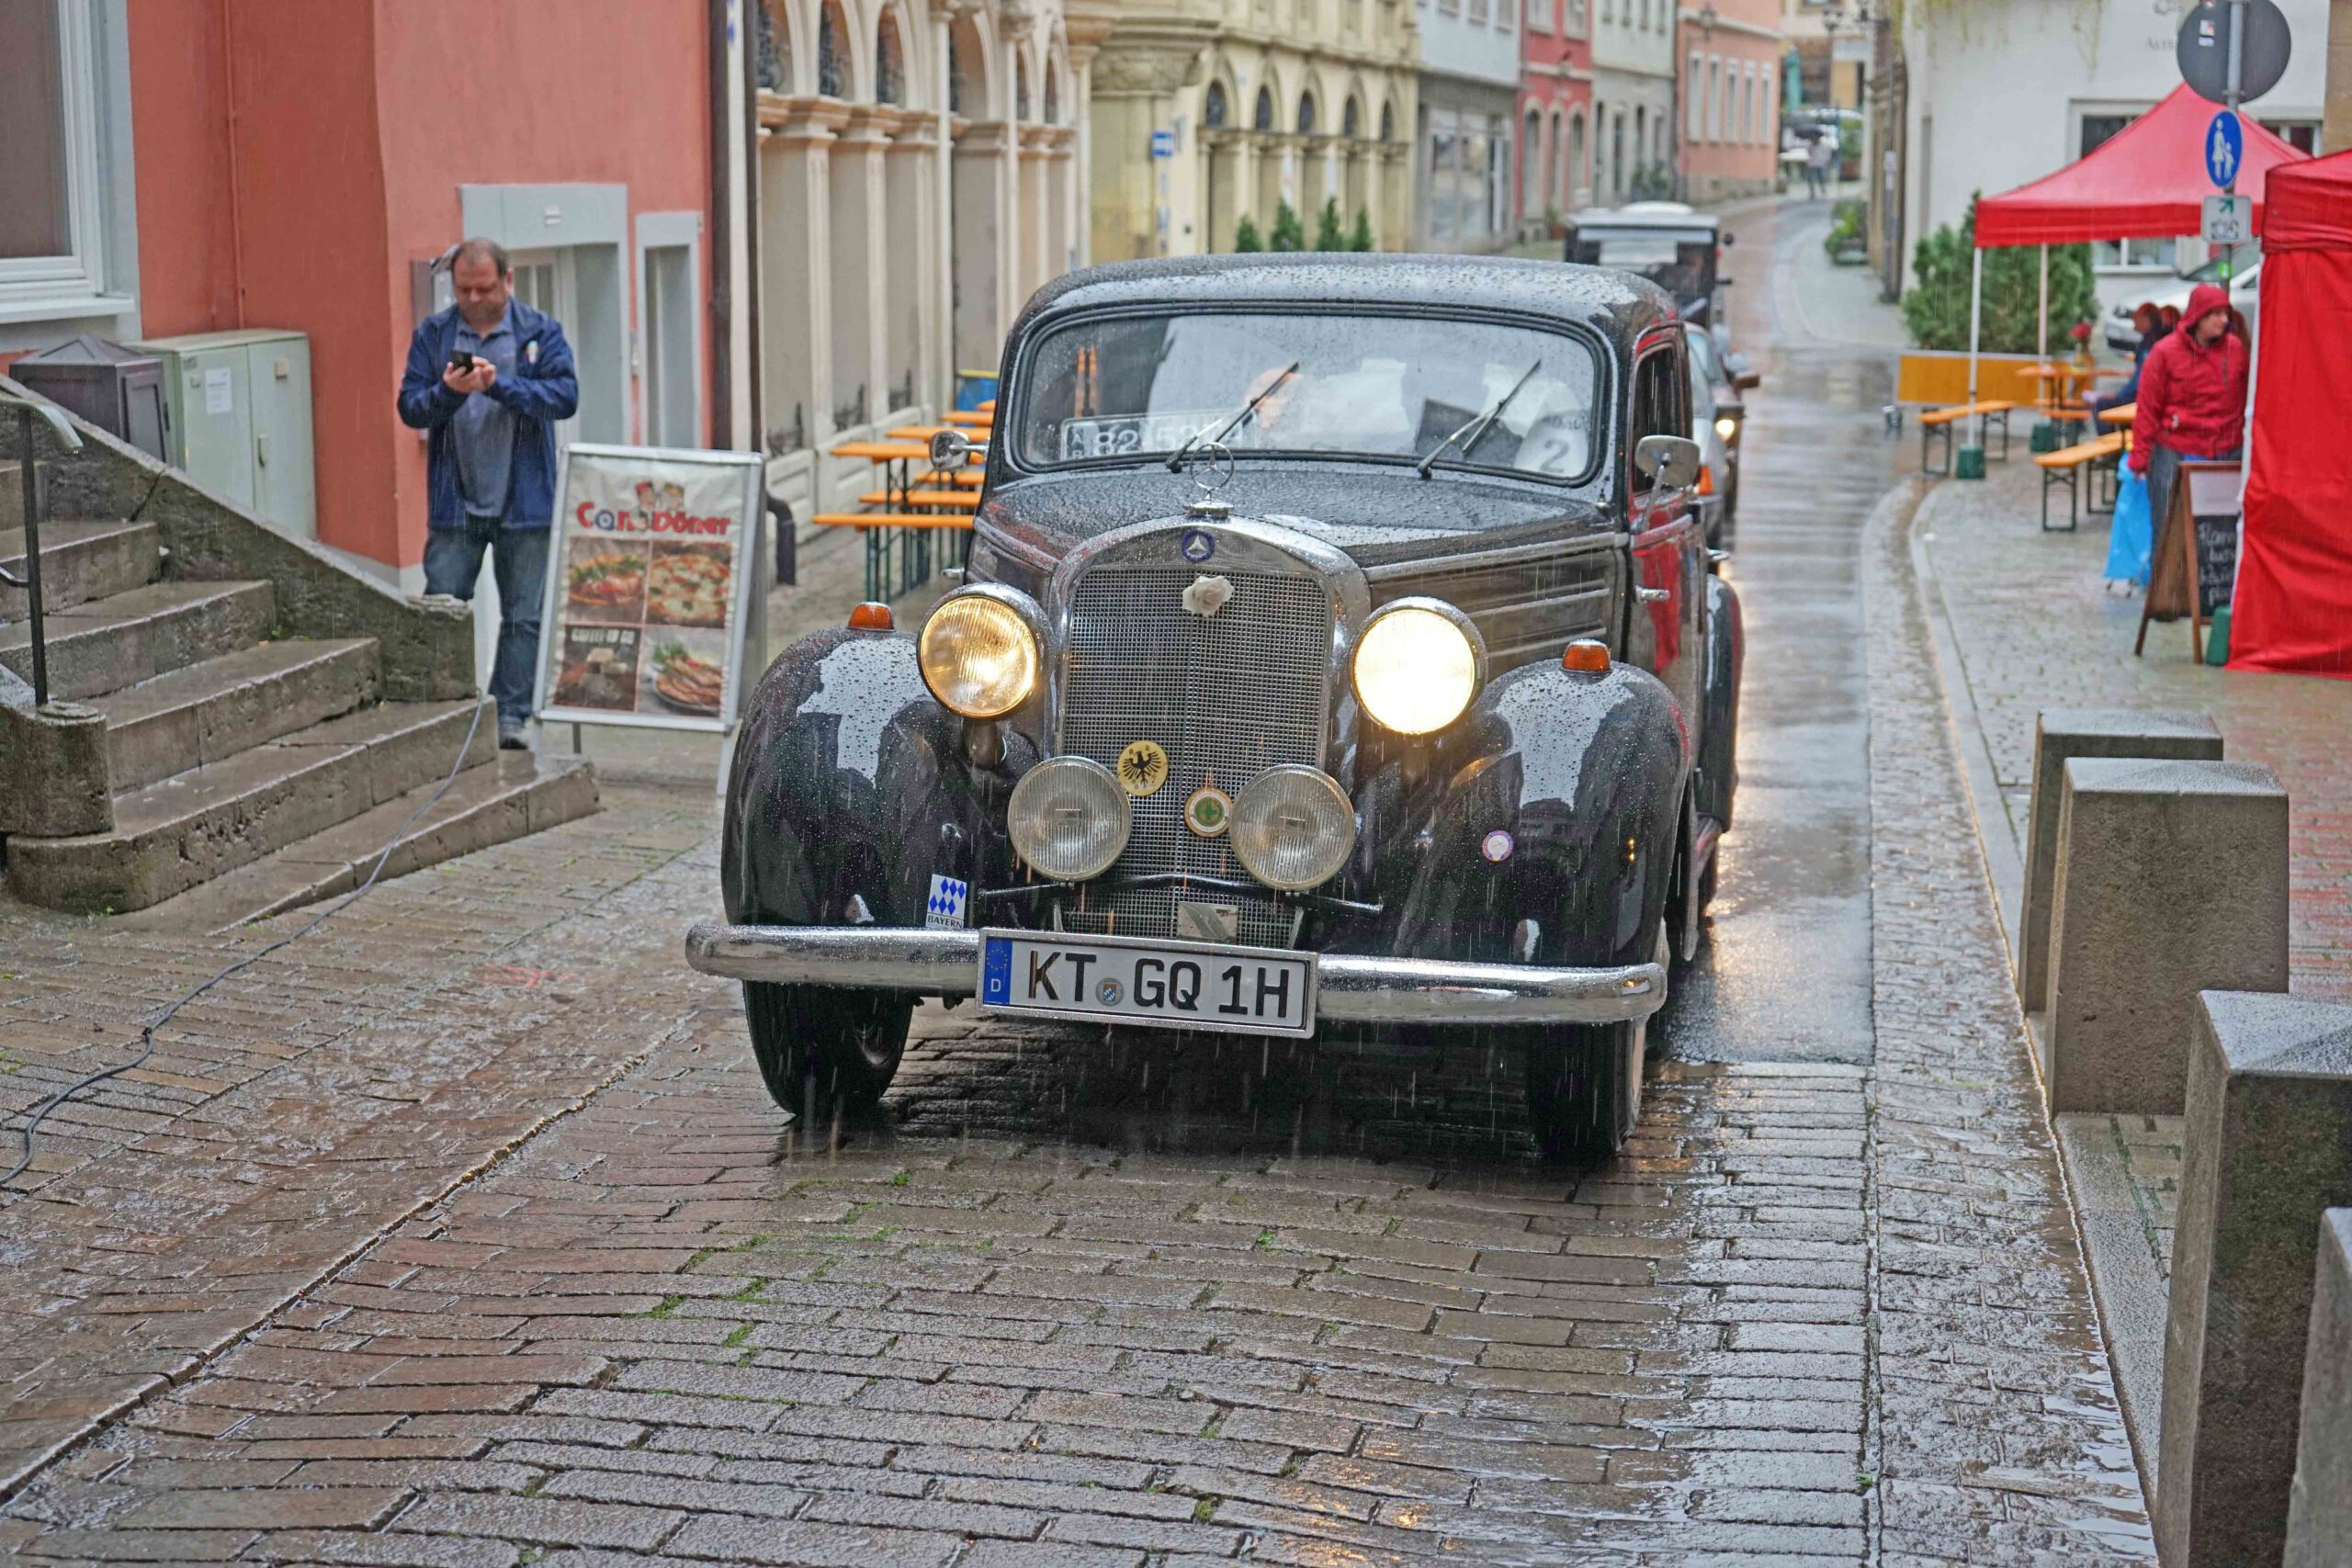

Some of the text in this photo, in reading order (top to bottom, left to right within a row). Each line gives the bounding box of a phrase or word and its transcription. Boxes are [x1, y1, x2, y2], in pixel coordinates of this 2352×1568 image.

[577, 502, 731, 536] Can Döner
[928, 915, 964, 929] BAYERN
[990, 977, 1001, 993] D
[1028, 950, 1289, 1018] KT GQ 1H
